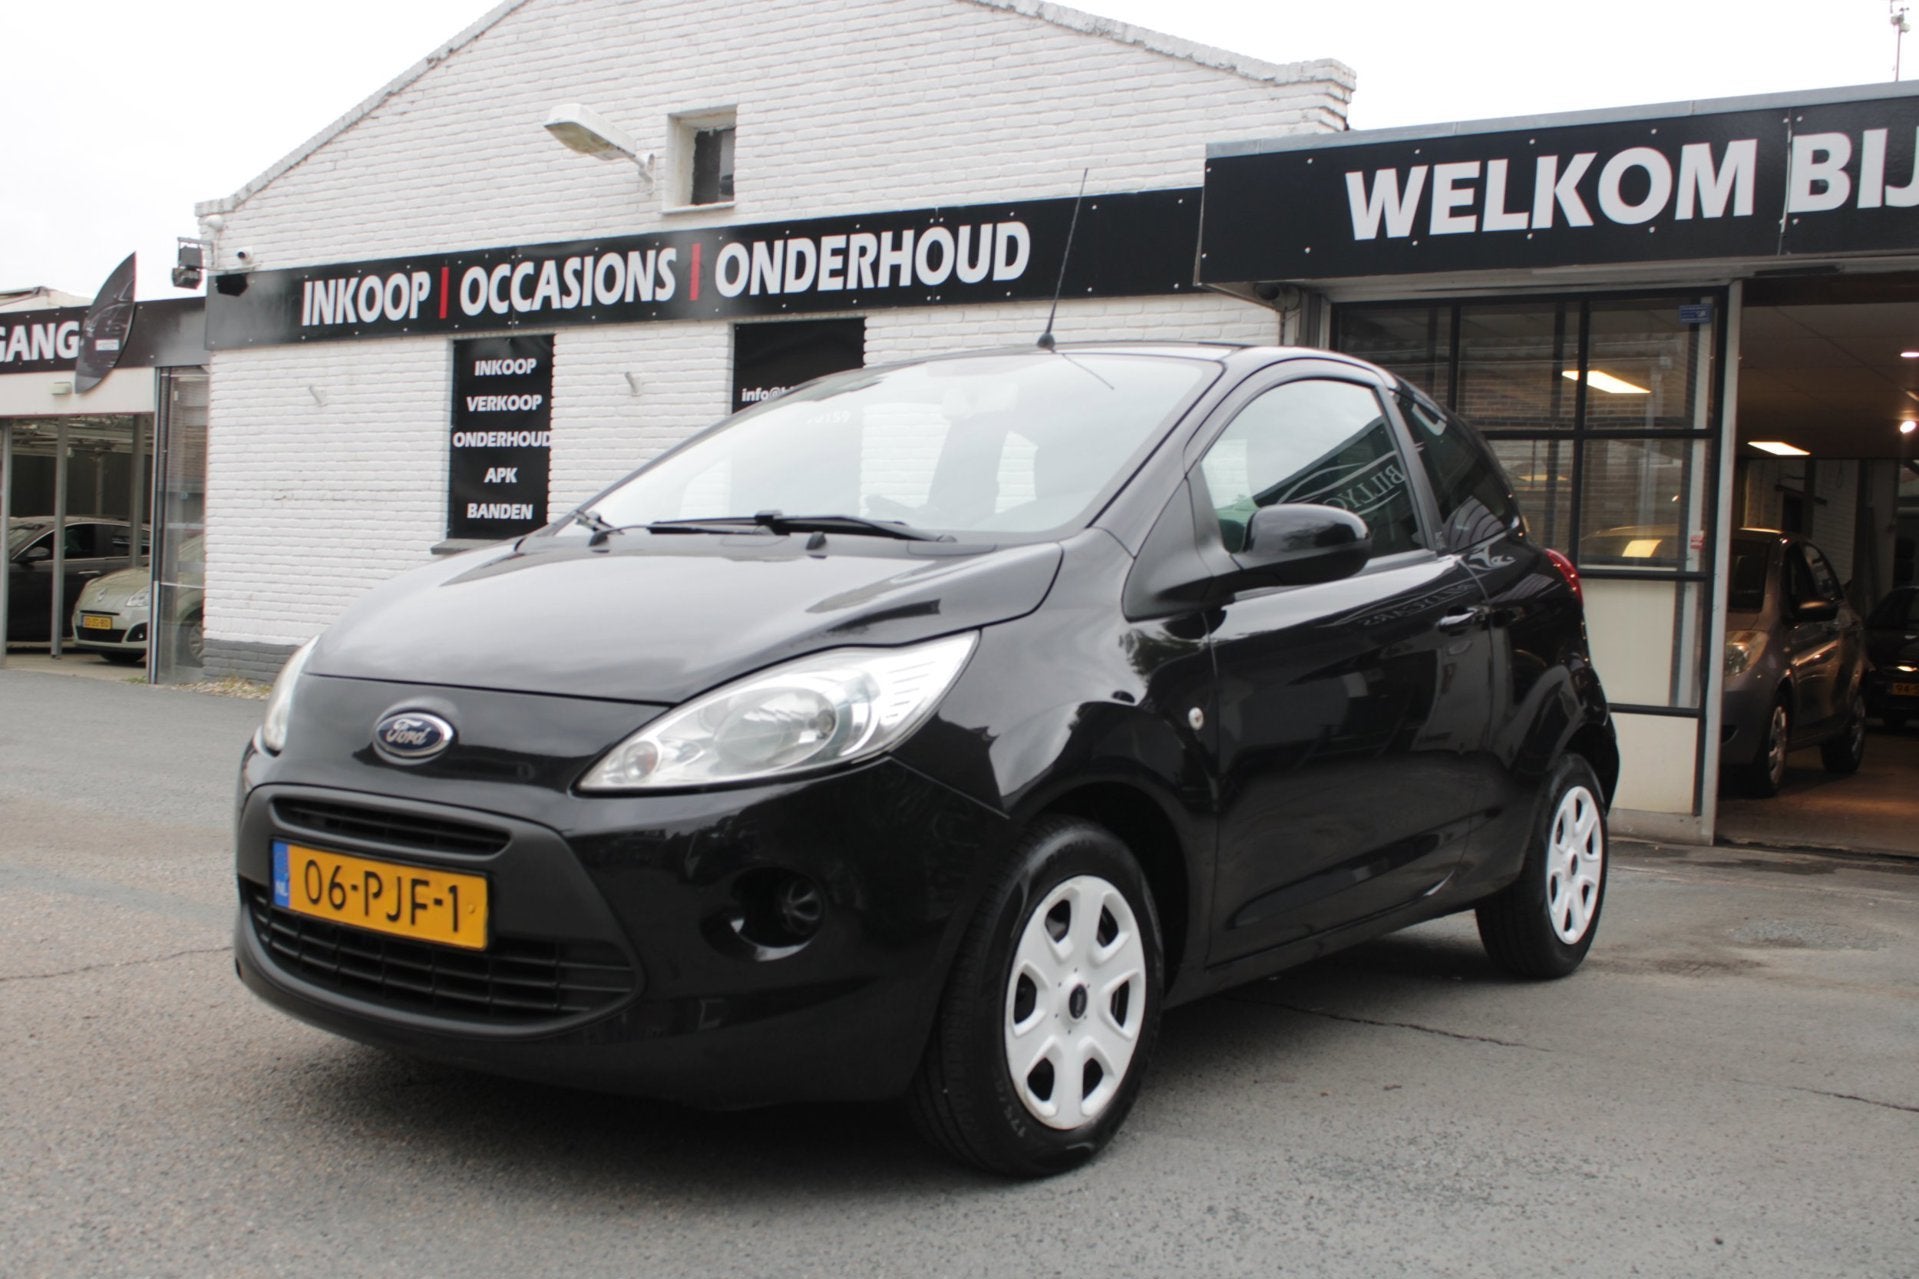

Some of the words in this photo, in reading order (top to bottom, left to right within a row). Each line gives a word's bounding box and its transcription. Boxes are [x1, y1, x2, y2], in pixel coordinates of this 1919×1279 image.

[1345, 138, 1758, 241] WELKOM
[302, 271, 431, 326] INKOOP
[459, 247, 677, 317] OCCASIONS
[715, 220, 1031, 298] ONDERHOUD
[0, 320, 79, 362] ANG
[474, 358, 537, 376] INKOOP
[466, 394, 543, 412] VERKOOP
[453, 430, 551, 448] ONDERHOUD
[484, 467, 518, 484] APK
[466, 503, 533, 520] BANDEN
[386, 718, 432, 746] Ford
[305, 859, 459, 933] 06-PJF-1
